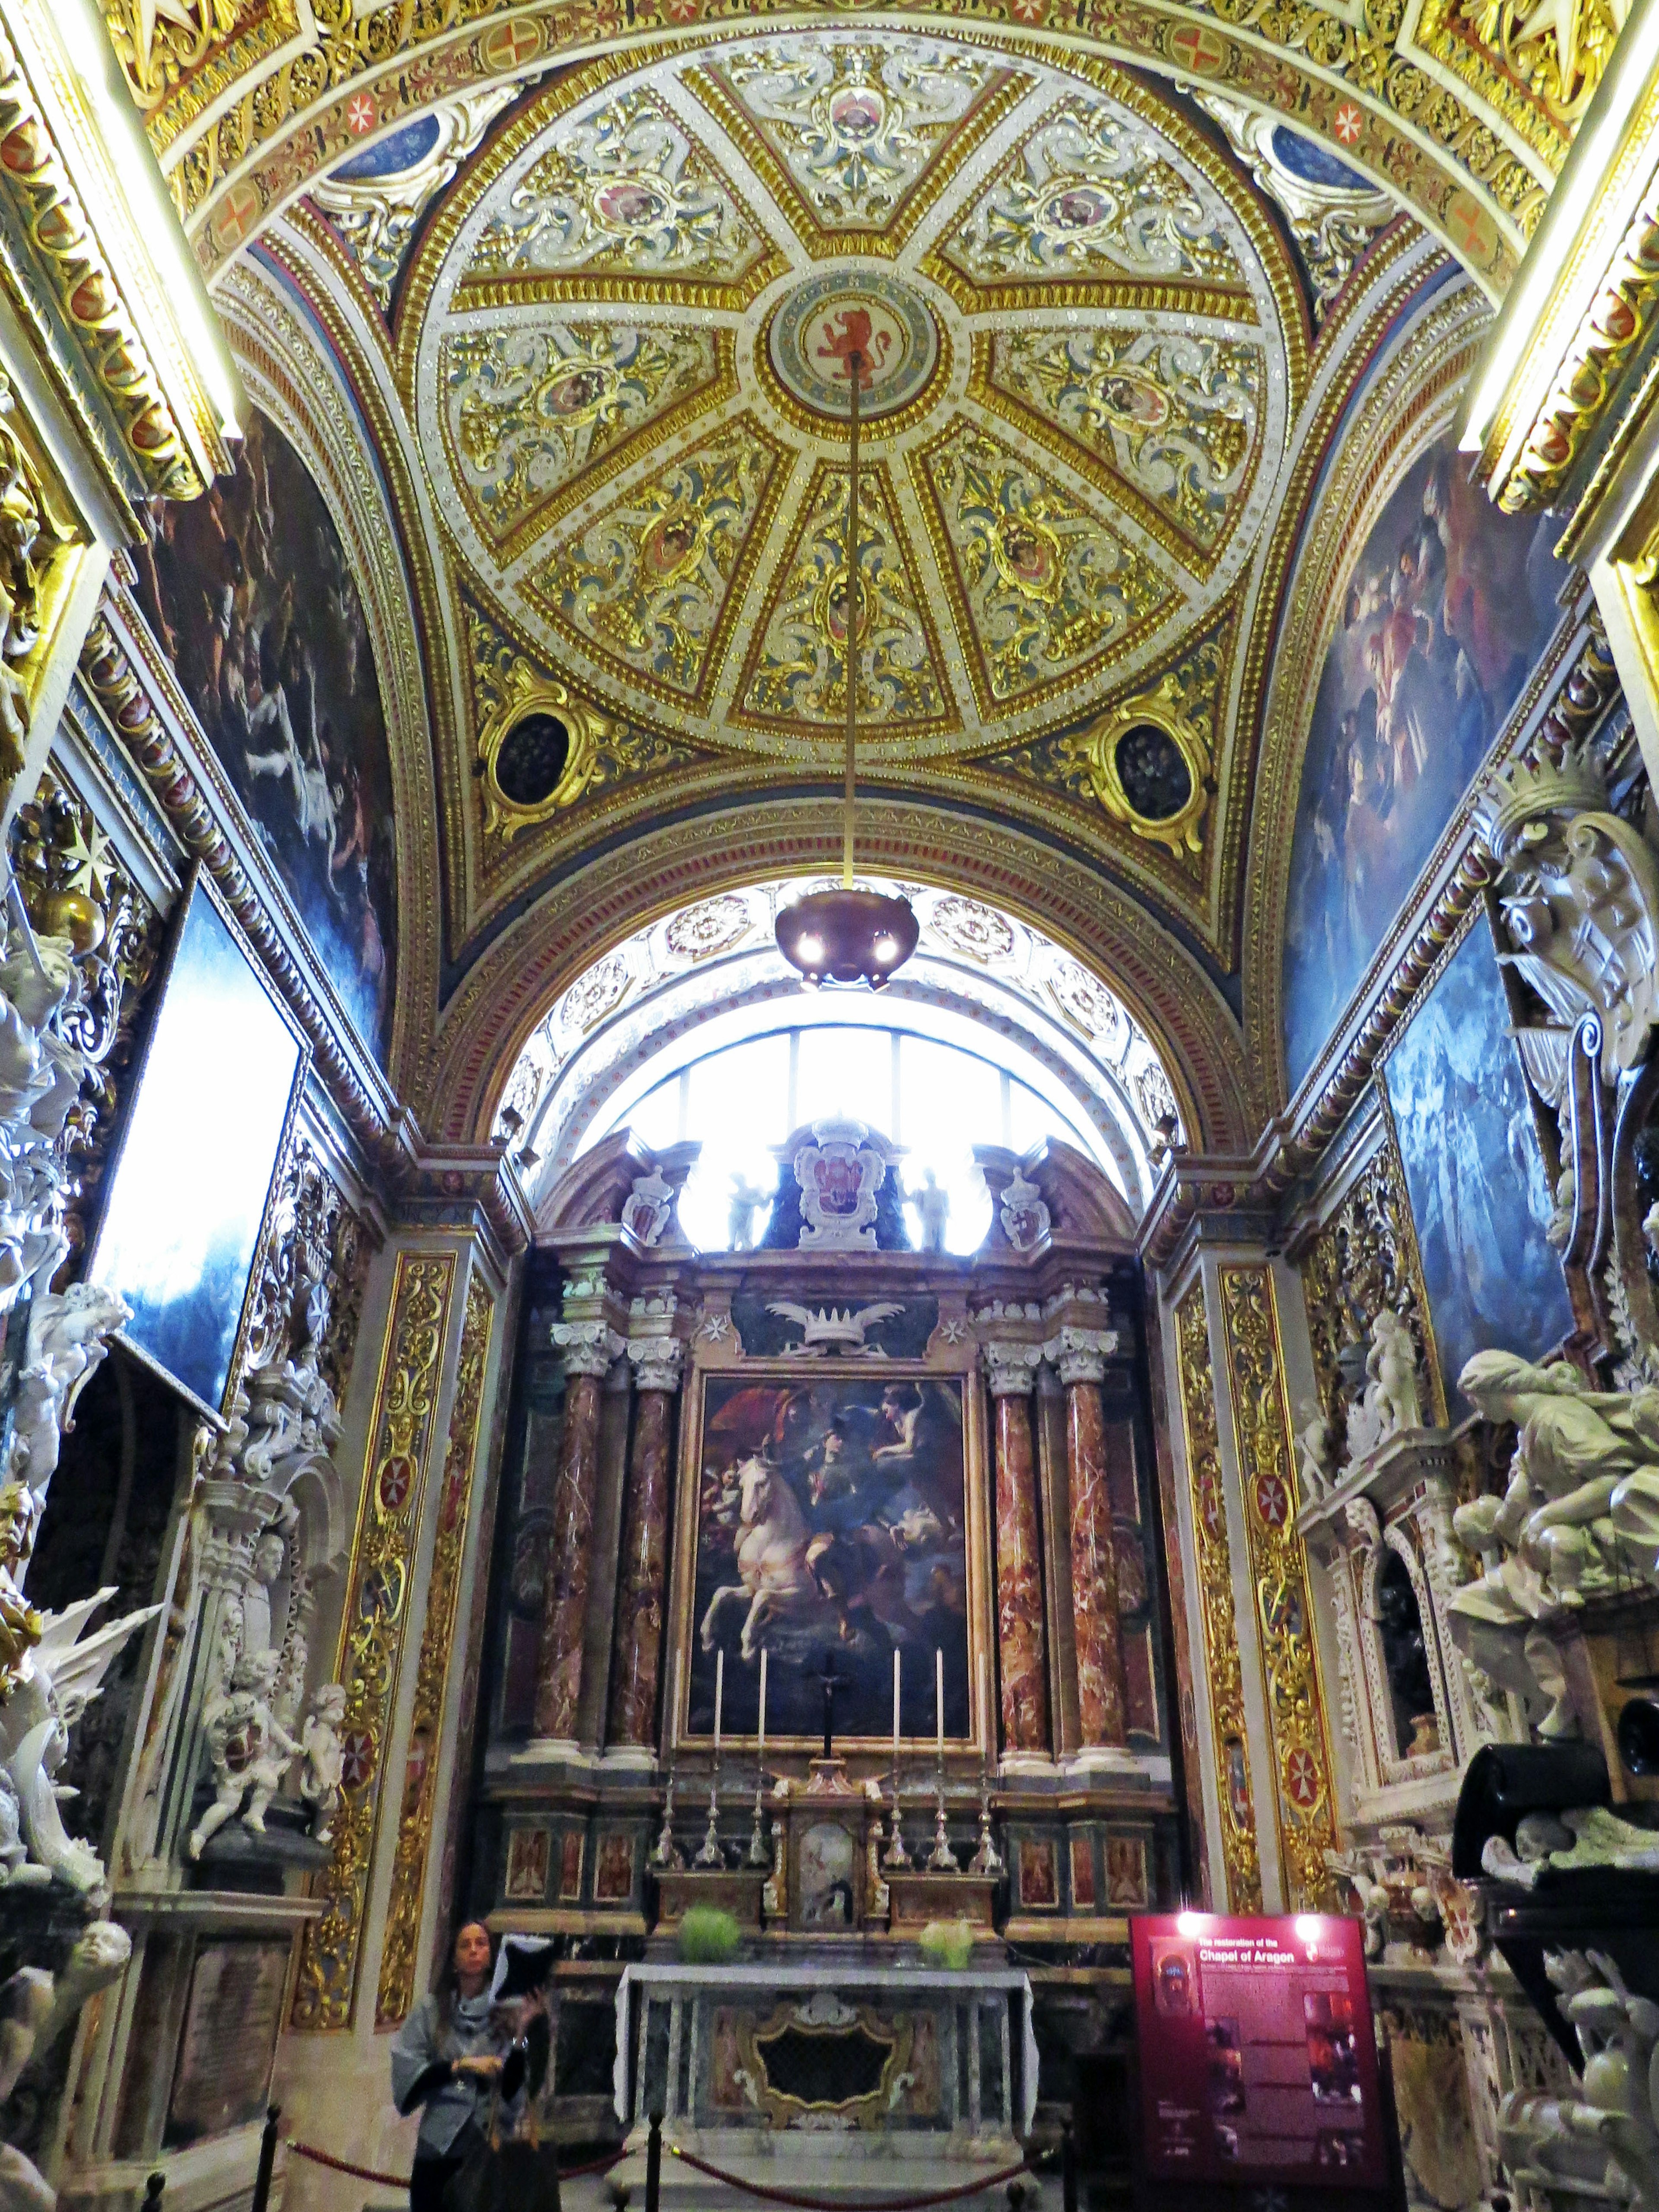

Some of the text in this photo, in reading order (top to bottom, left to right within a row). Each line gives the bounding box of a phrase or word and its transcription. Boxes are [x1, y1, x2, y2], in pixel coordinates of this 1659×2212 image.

[1214, 1939, 1255, 1947] restoration
[1256, 1939, 1264, 1947] of
[1265, 1939, 1278, 1948] the
[1200, 1949, 1294, 1964] Chapel of Aragon
